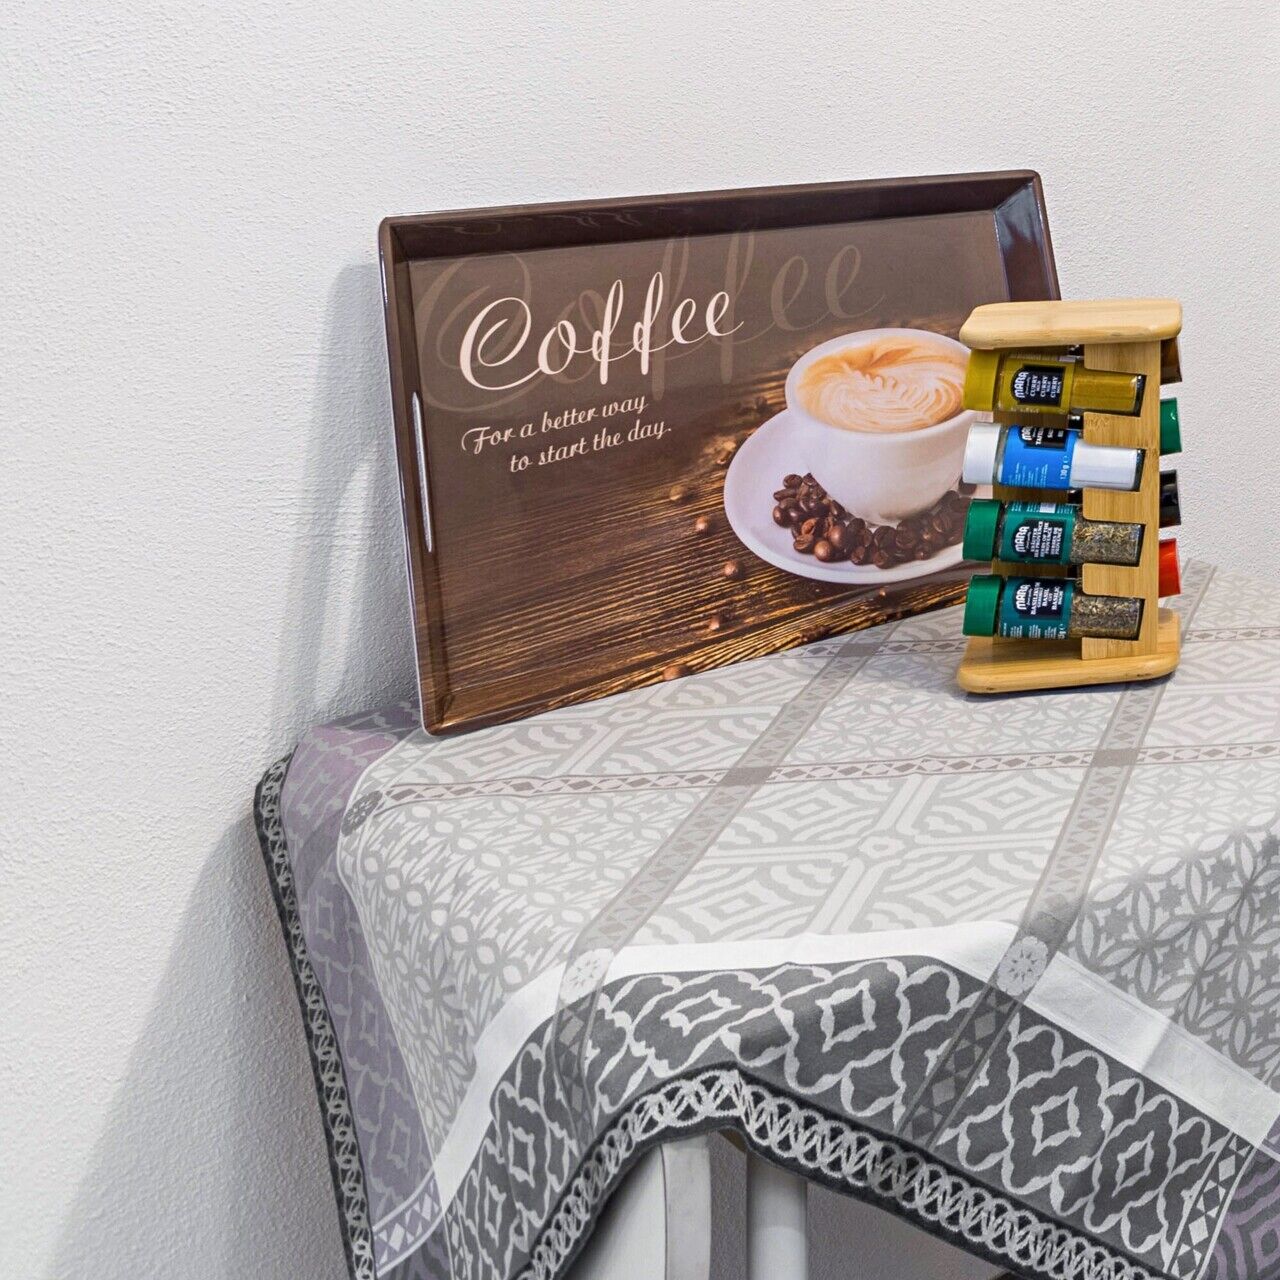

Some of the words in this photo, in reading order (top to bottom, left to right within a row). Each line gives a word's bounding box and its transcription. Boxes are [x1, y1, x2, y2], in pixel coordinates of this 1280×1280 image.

[459, 271, 744, 390] Coffee
[1014, 371, 1029, 398] MARA
[1030, 375, 1038, 397] CURRY
[1040, 376, 1048, 397] CURRY
[1050, 376, 1058, 398] CURRY
[461, 426, 516, 455] For
[520, 422, 537, 438] a
[541, 406, 599, 433] better
[602, 395, 649, 417] way
[510, 454, 532, 473] to
[538, 437, 589, 466] start
[592, 427, 624, 451] the
[627, 419, 672, 440] day.
[1014, 526, 1030, 552] MARA
[1015, 584, 1031, 610] MARA
